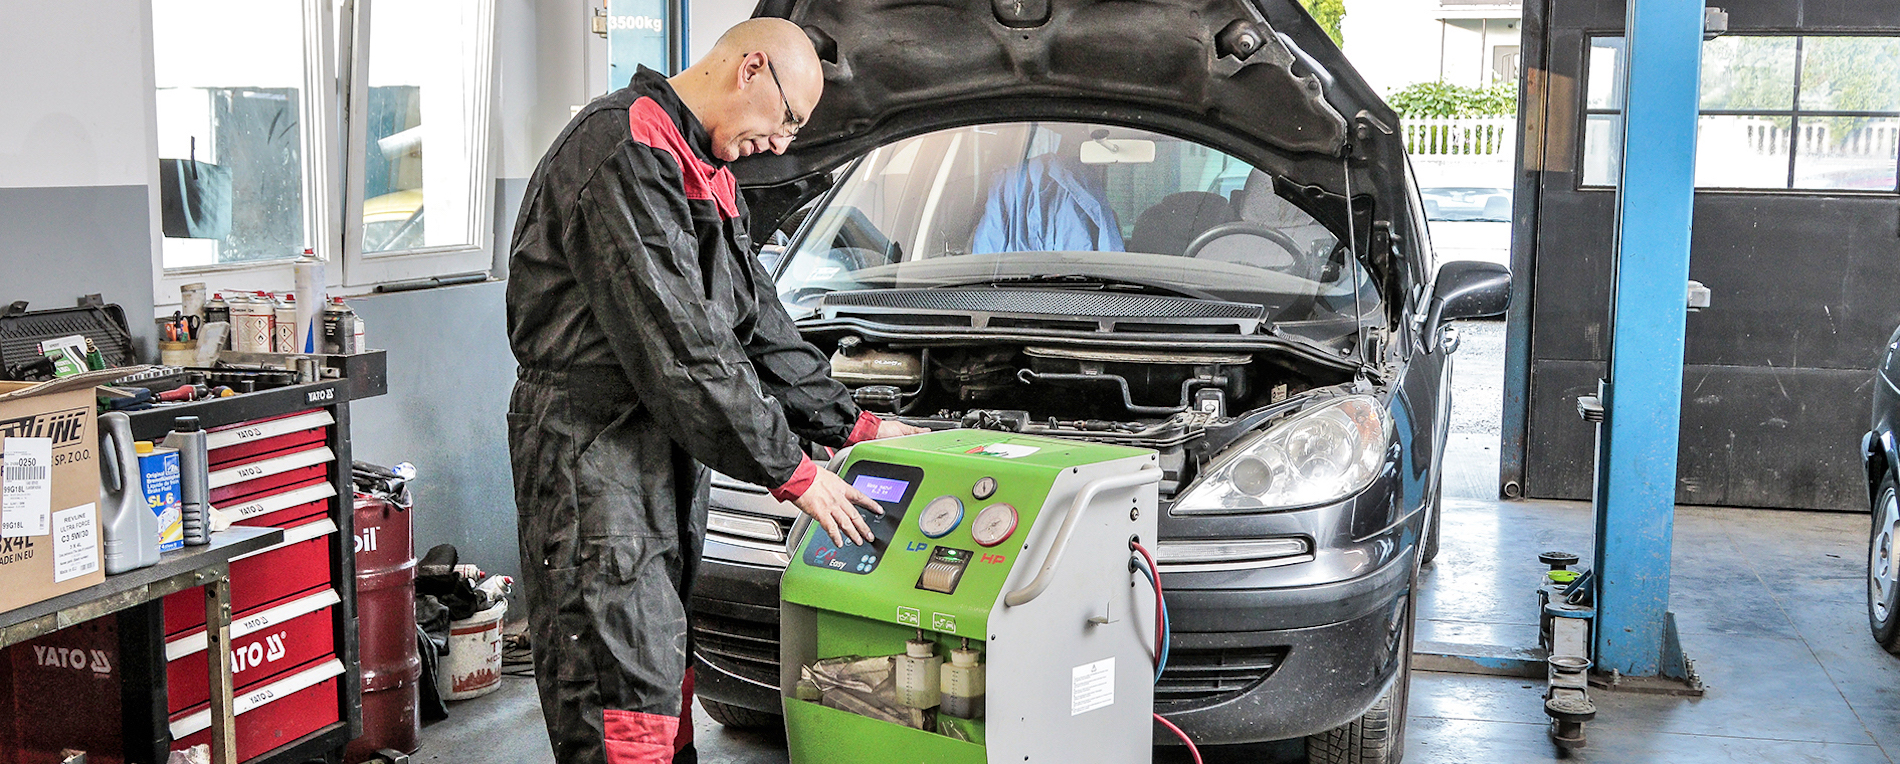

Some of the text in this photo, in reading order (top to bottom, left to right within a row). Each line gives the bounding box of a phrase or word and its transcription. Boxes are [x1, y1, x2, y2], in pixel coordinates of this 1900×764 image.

[610, 15, 662, 32] 3500kg
[308, 390, 326, 402] YATO
[236, 429, 254, 439] YATO
[237, 467, 255, 478] YATO
[238, 505, 257, 516] YATO
[906, 541, 928, 552] LP
[14, 552, 22, 562] IN
[24, 549, 34, 560] EU
[980, 553, 1006, 565] HP
[829, 559, 847, 570] Easy
[243, 618, 261, 629] YATO
[32, 644, 87, 670] YATO
[230, 641, 263, 674] ATO
[249, 692, 267, 704] YATO
